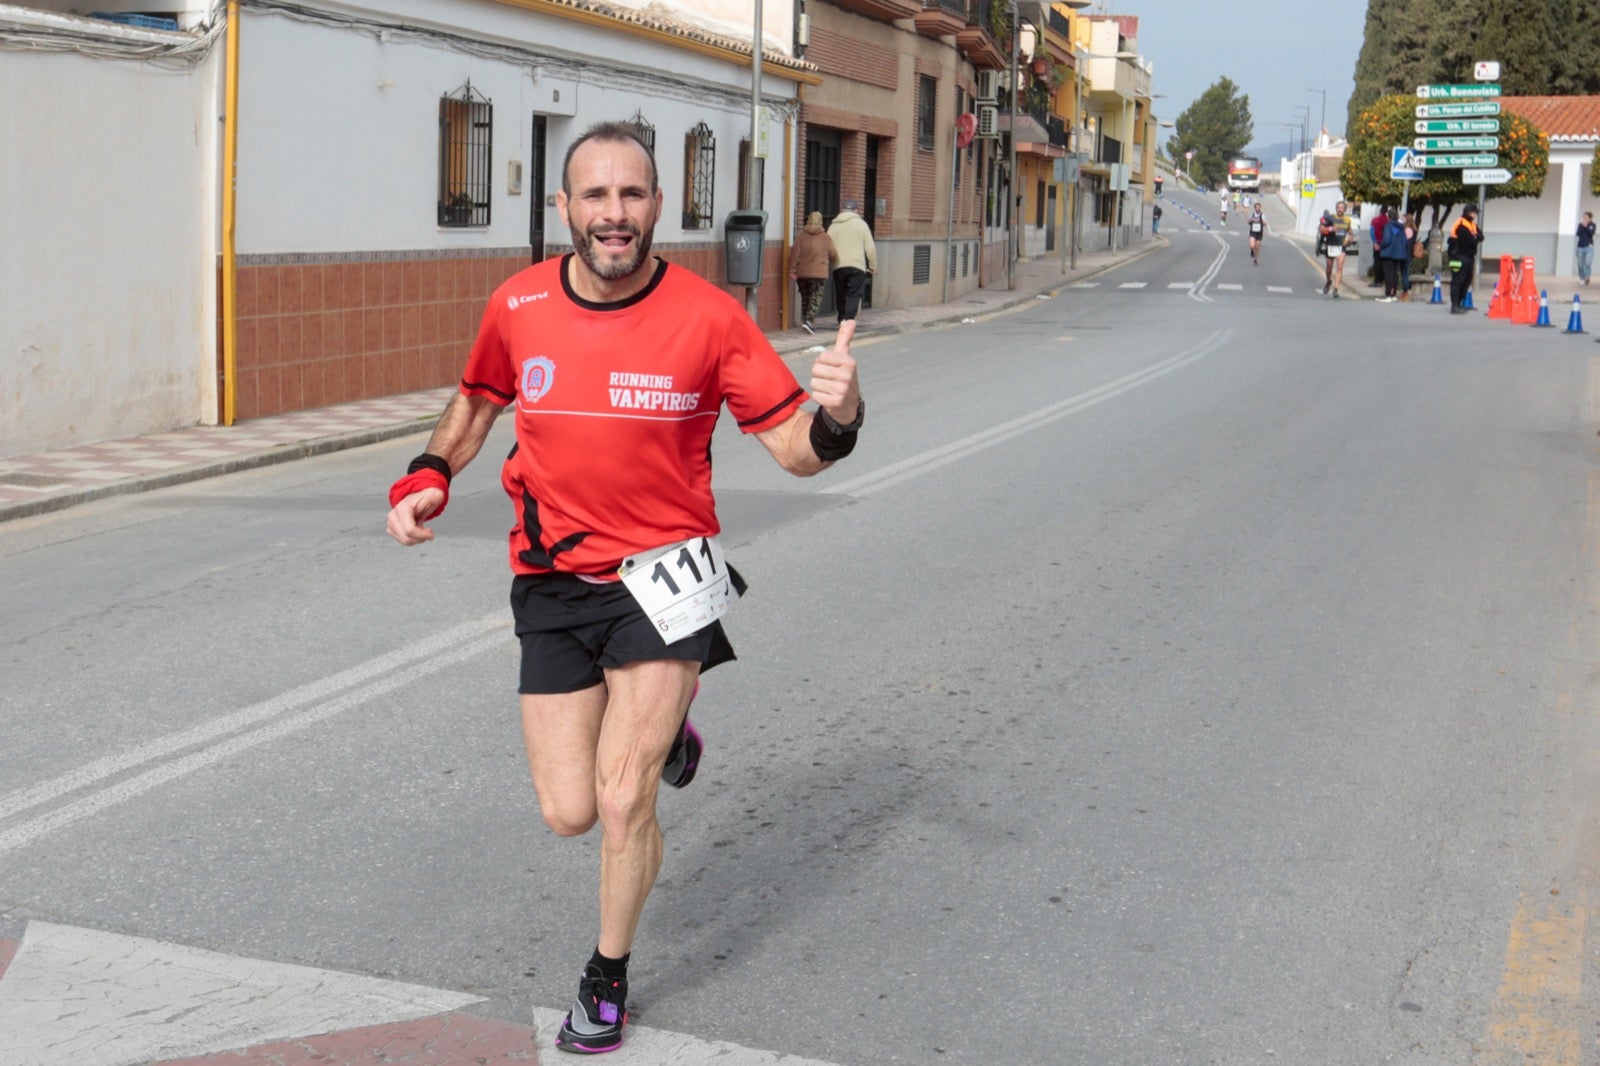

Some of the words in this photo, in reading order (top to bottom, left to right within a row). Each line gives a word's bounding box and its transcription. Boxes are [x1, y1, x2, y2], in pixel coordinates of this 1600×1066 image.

[1430, 87, 1449, 97] Urb.
[1450, 87, 1499, 97] Buenavista
[1447, 122, 1461, 130] Urb.
[1437, 139, 1452, 148] Urb.
[1435, 157, 1450, 165] Urb.
[608, 371, 673, 389] RUNNING
[608, 388, 701, 411] VAMPIROS
[650, 536, 717, 596] 111
